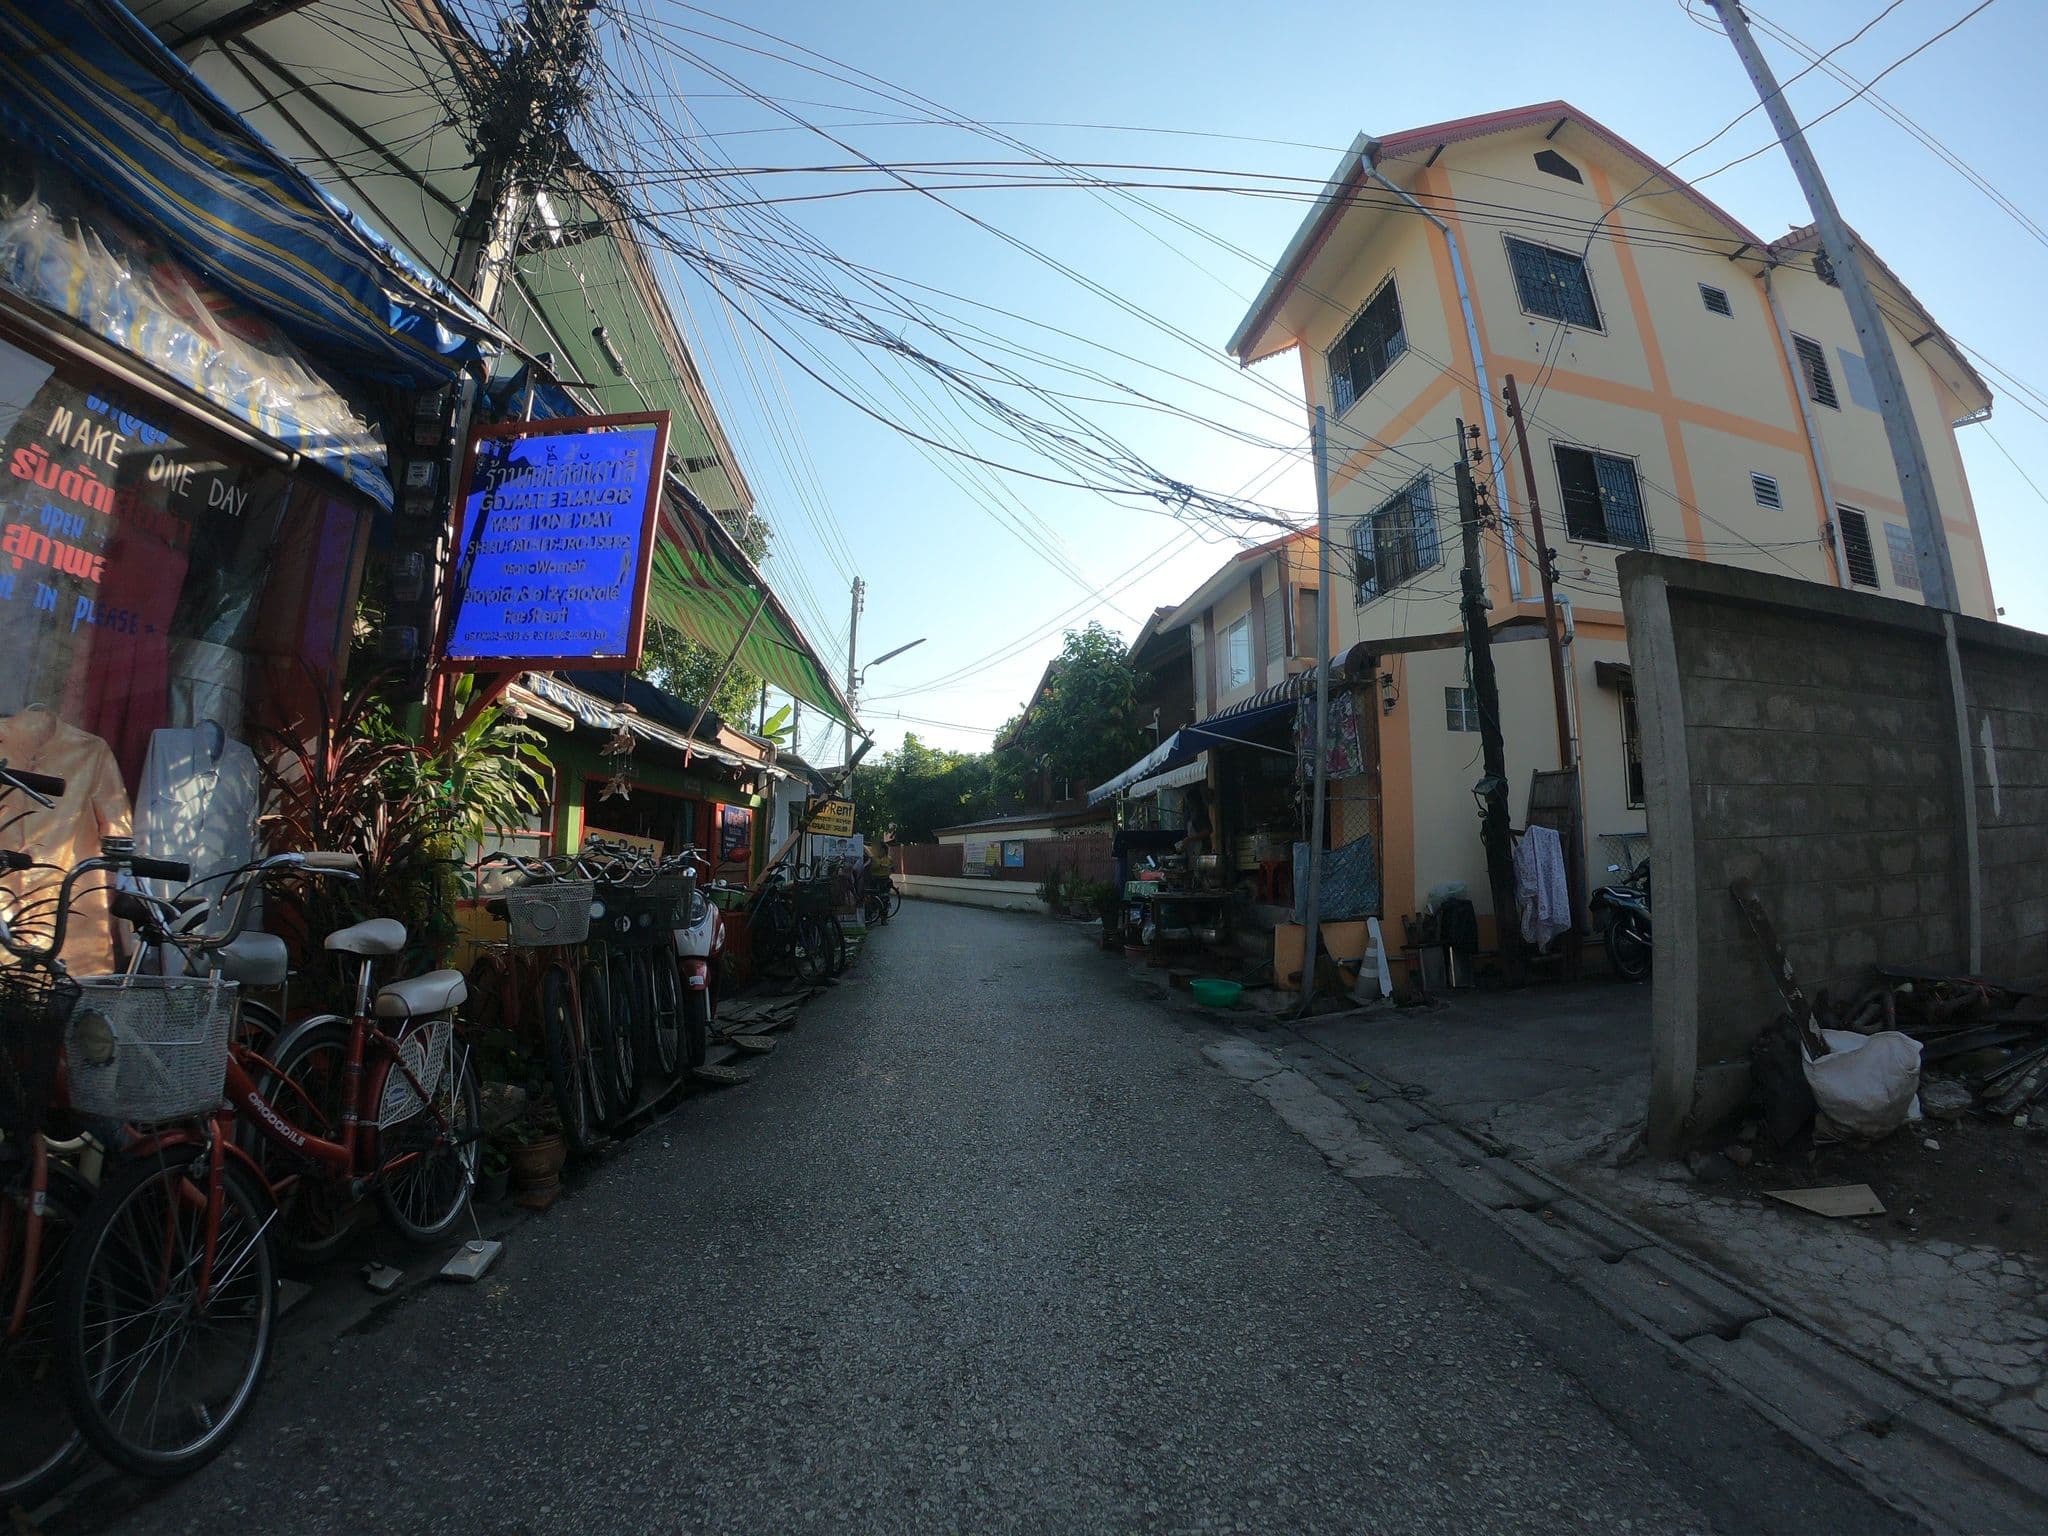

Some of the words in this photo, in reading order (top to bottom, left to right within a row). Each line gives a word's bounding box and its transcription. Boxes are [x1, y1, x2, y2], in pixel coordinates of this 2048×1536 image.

[46, 406, 126, 468] MAKE
[147, 454, 196, 498] ONE
[208, 478, 249, 517] DAY
[33, 582, 58, 613] IN
[831, 802, 853, 817] Rent
